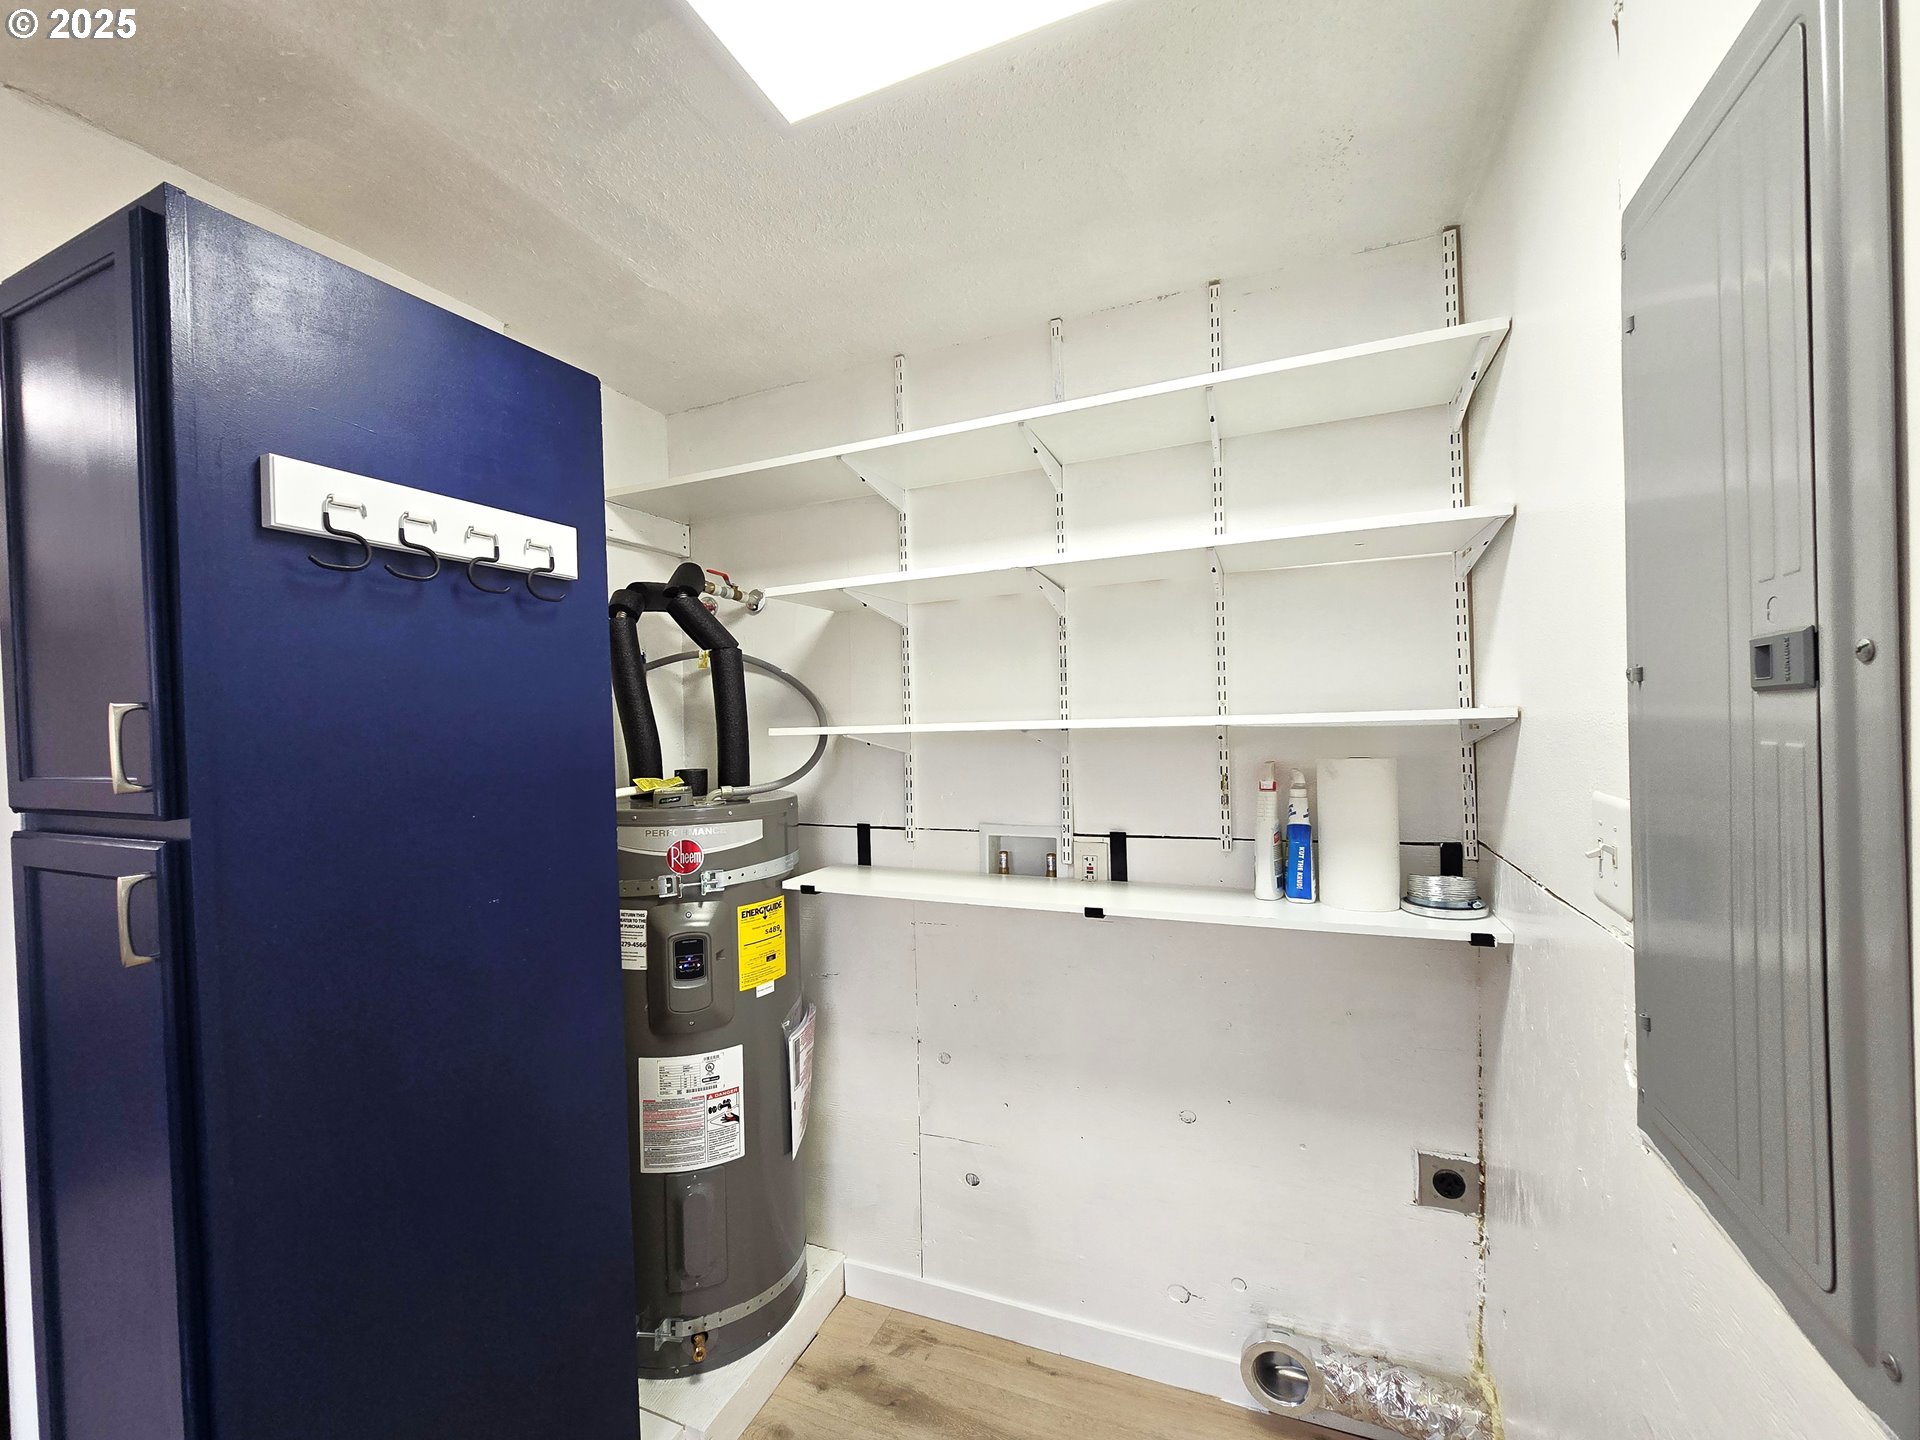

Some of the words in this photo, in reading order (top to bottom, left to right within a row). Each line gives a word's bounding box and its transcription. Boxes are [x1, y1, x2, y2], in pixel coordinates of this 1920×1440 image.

[645, 826, 727, 838] PERFORMANCE
[671, 840, 701, 869] Rheem
[741, 900, 782, 919] ENERGYGUIDE
[765, 924, 780, 934] $489
[714, 1088, 738, 1098] DANGER
